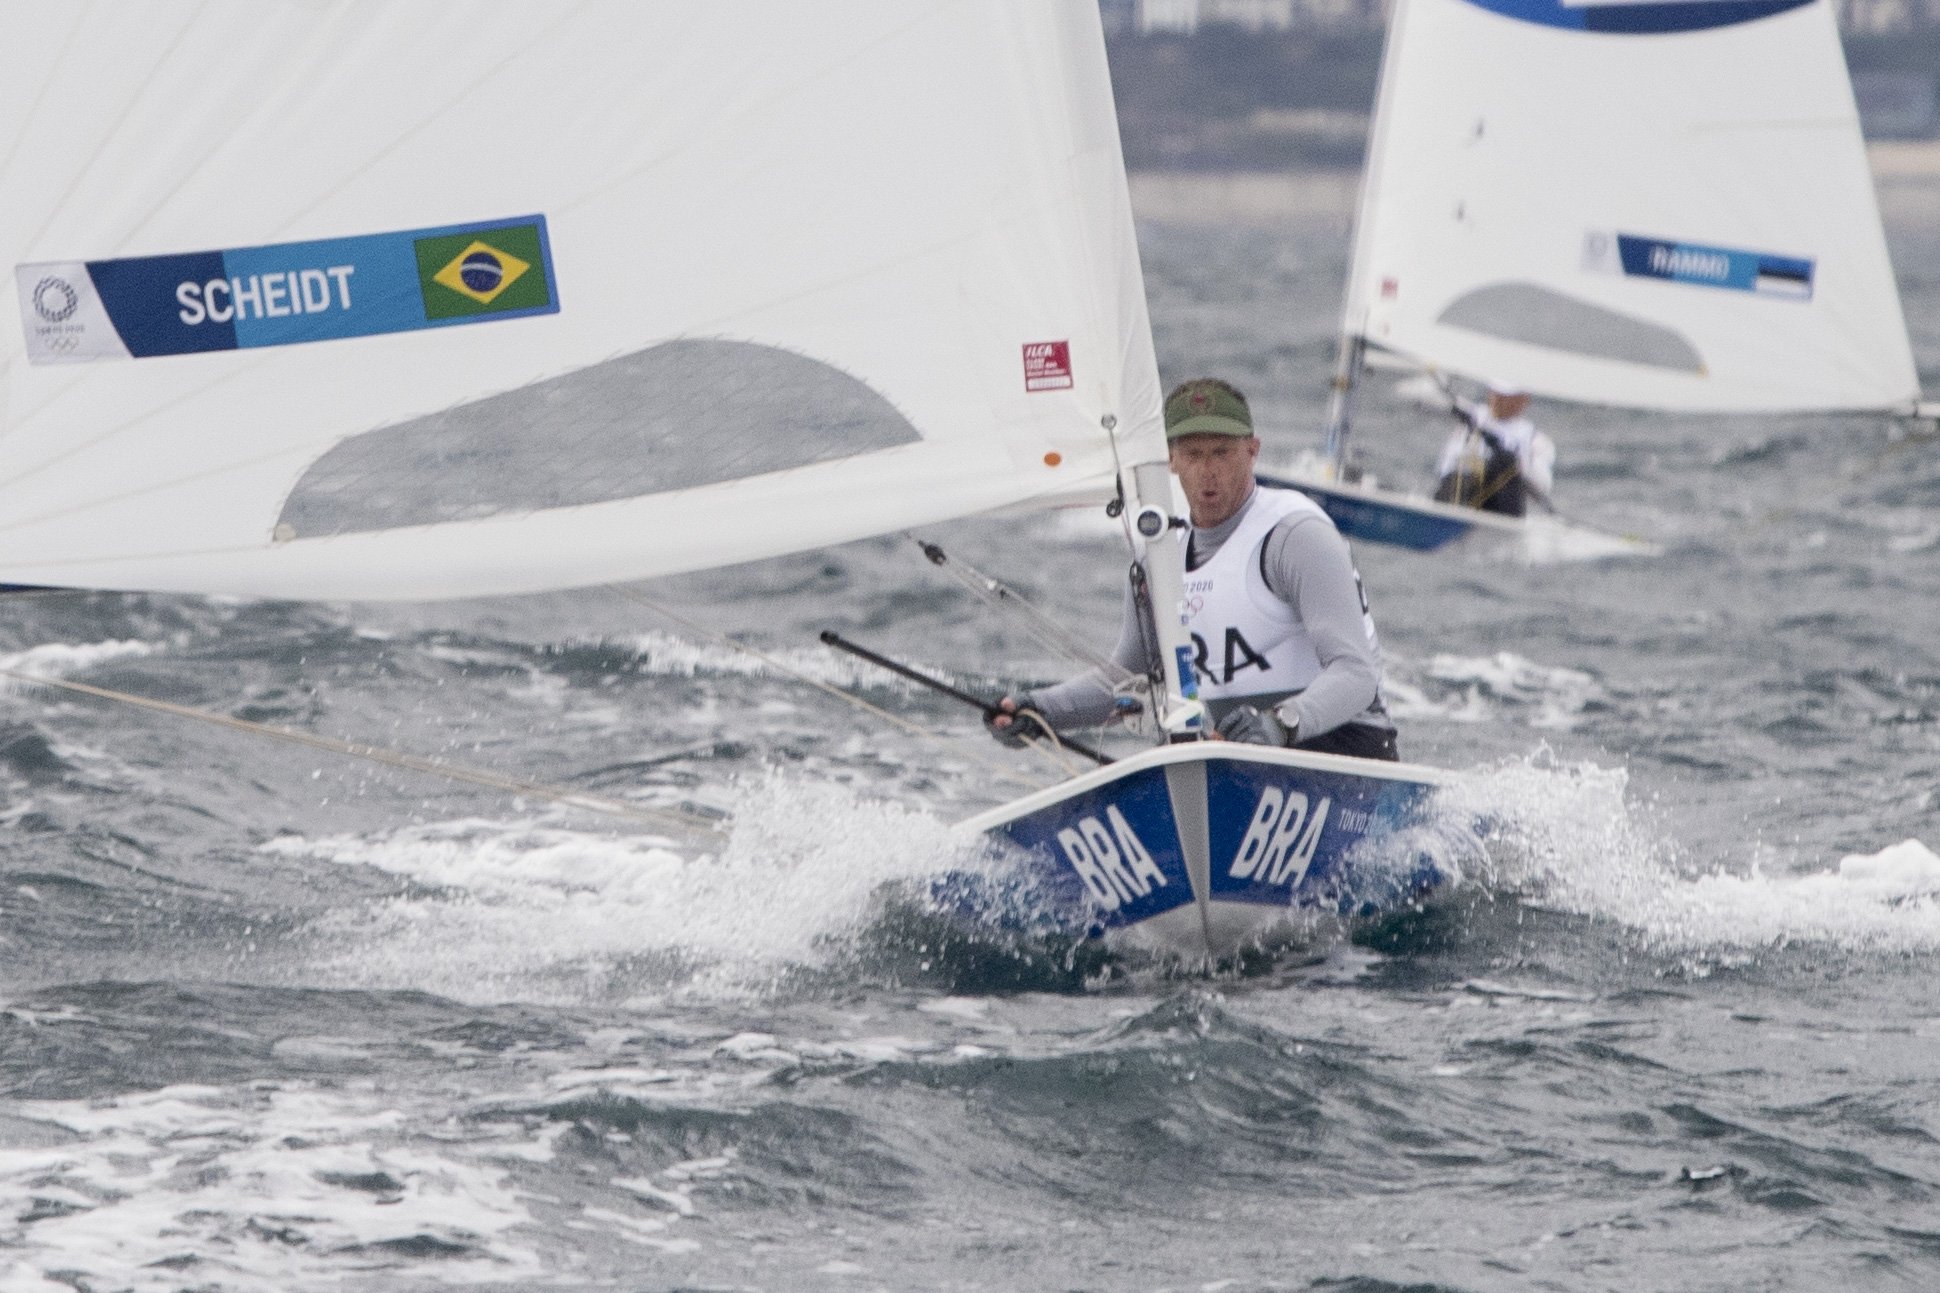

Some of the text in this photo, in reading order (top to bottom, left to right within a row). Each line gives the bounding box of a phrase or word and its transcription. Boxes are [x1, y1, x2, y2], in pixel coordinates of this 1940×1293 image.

[176, 266, 354, 325] SCHEIDT
[1190, 581, 1214, 593] 2020
[1190, 627, 1271, 686] RA
[1057, 804, 1167, 912] BRA
[1229, 786, 1331, 887] BRA
